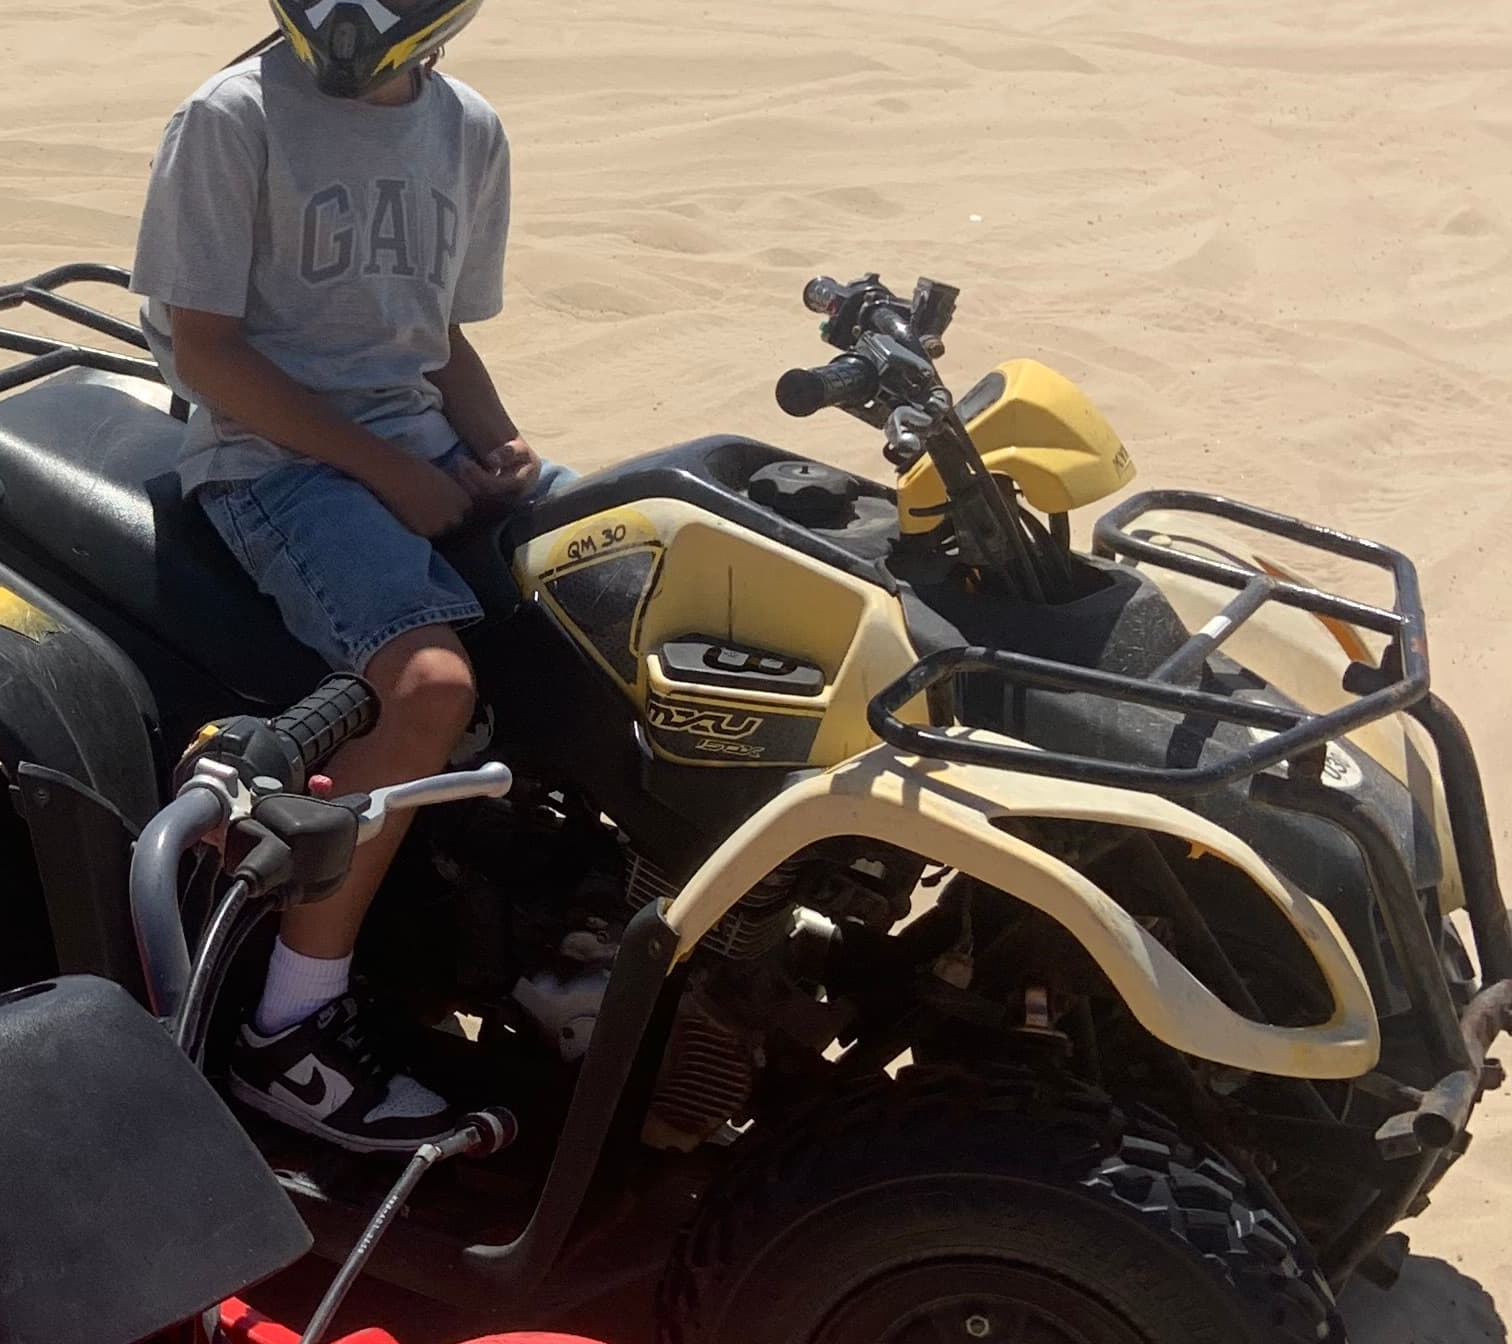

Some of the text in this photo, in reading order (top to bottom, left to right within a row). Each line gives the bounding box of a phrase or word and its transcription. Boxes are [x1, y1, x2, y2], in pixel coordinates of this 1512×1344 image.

[298, 177, 458, 290] GAP
[567, 523, 626, 560] QM 30
